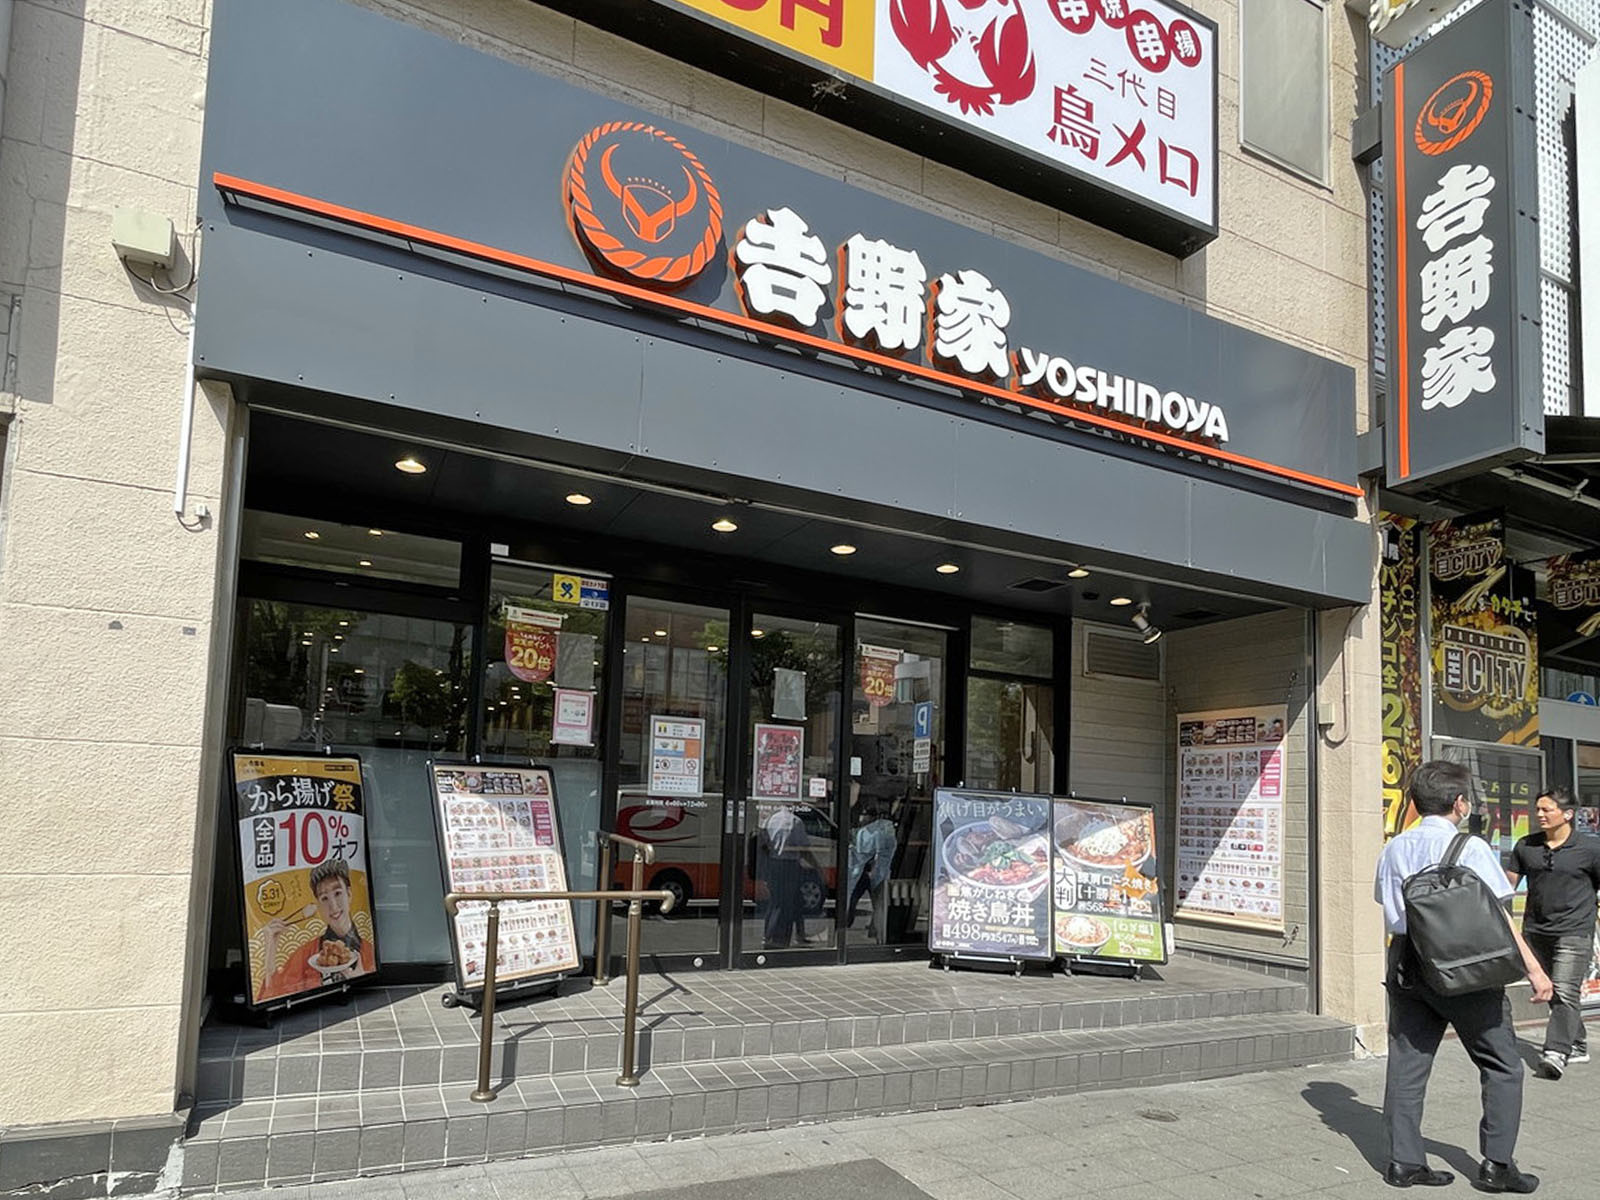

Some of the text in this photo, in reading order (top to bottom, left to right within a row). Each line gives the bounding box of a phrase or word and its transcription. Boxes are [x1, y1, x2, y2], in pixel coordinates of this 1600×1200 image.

[1083, 57, 1176, 120] 三代目
[1046, 84, 1199, 197] 鳥メロ
[735, 206, 1011, 379] 吉野家
[1416, 164, 1496, 411] 吉野家
[1017, 345, 1230, 444] YOSHINOYA
[1381, 562, 1403, 838] パチンコ全267
[1447, 650, 1527, 700] THE CITY
[247, 776, 356, 813] から揚げ祭
[939, 801, 1048, 818] 焦げ目がうまい。
[255, 819, 275, 867] 全品
[332, 838, 359, 861] オフ
[947, 897, 1036, 927] 焼き鳥丼
[1055, 868, 1075, 906] 大判
